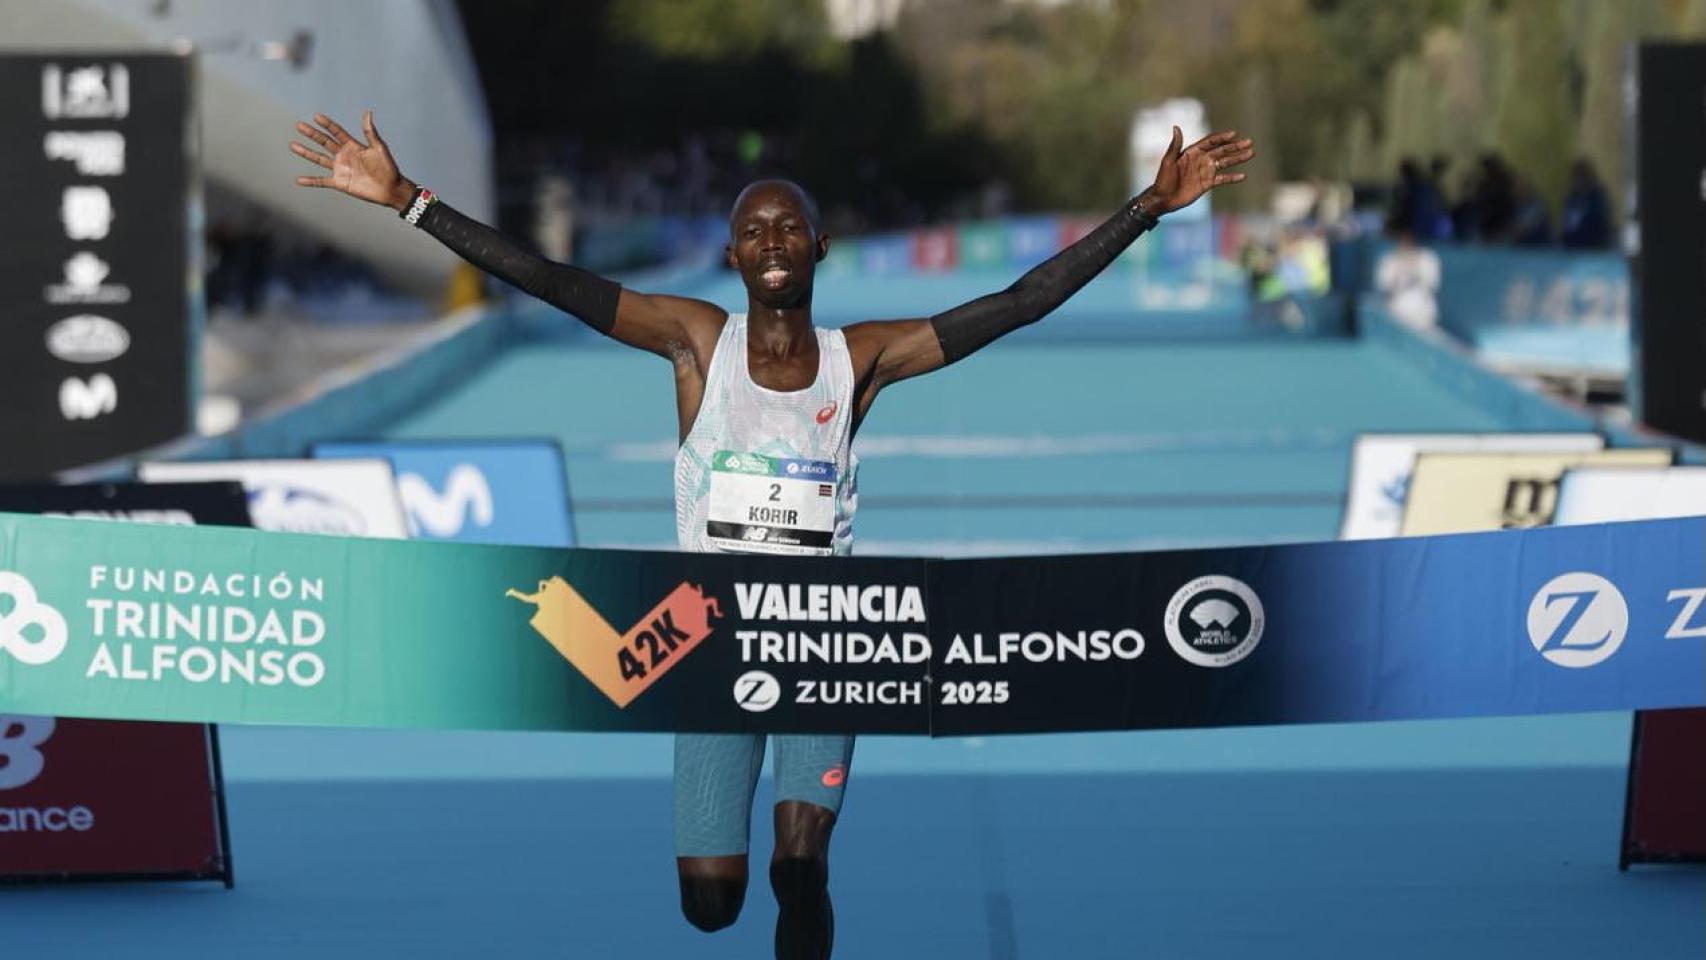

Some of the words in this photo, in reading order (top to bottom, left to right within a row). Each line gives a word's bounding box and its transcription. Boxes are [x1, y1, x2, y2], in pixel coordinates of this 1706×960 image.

[769, 483, 782, 501] 2
[749, 506, 798, 525] KORIR
[90, 566, 324, 600] FUNDACIÓN
[734, 583, 926, 623] VALENCIA
[86, 599, 325, 646] TRINIDAD
[617, 609, 690, 684] 42K
[735, 632, 932, 664] TRINIDAD
[945, 629, 1145, 664] ALFONSO
[86, 643, 325, 686] ALFONSO
[795, 680, 921, 705] ZURICH
[941, 681, 1009, 704] 2025
